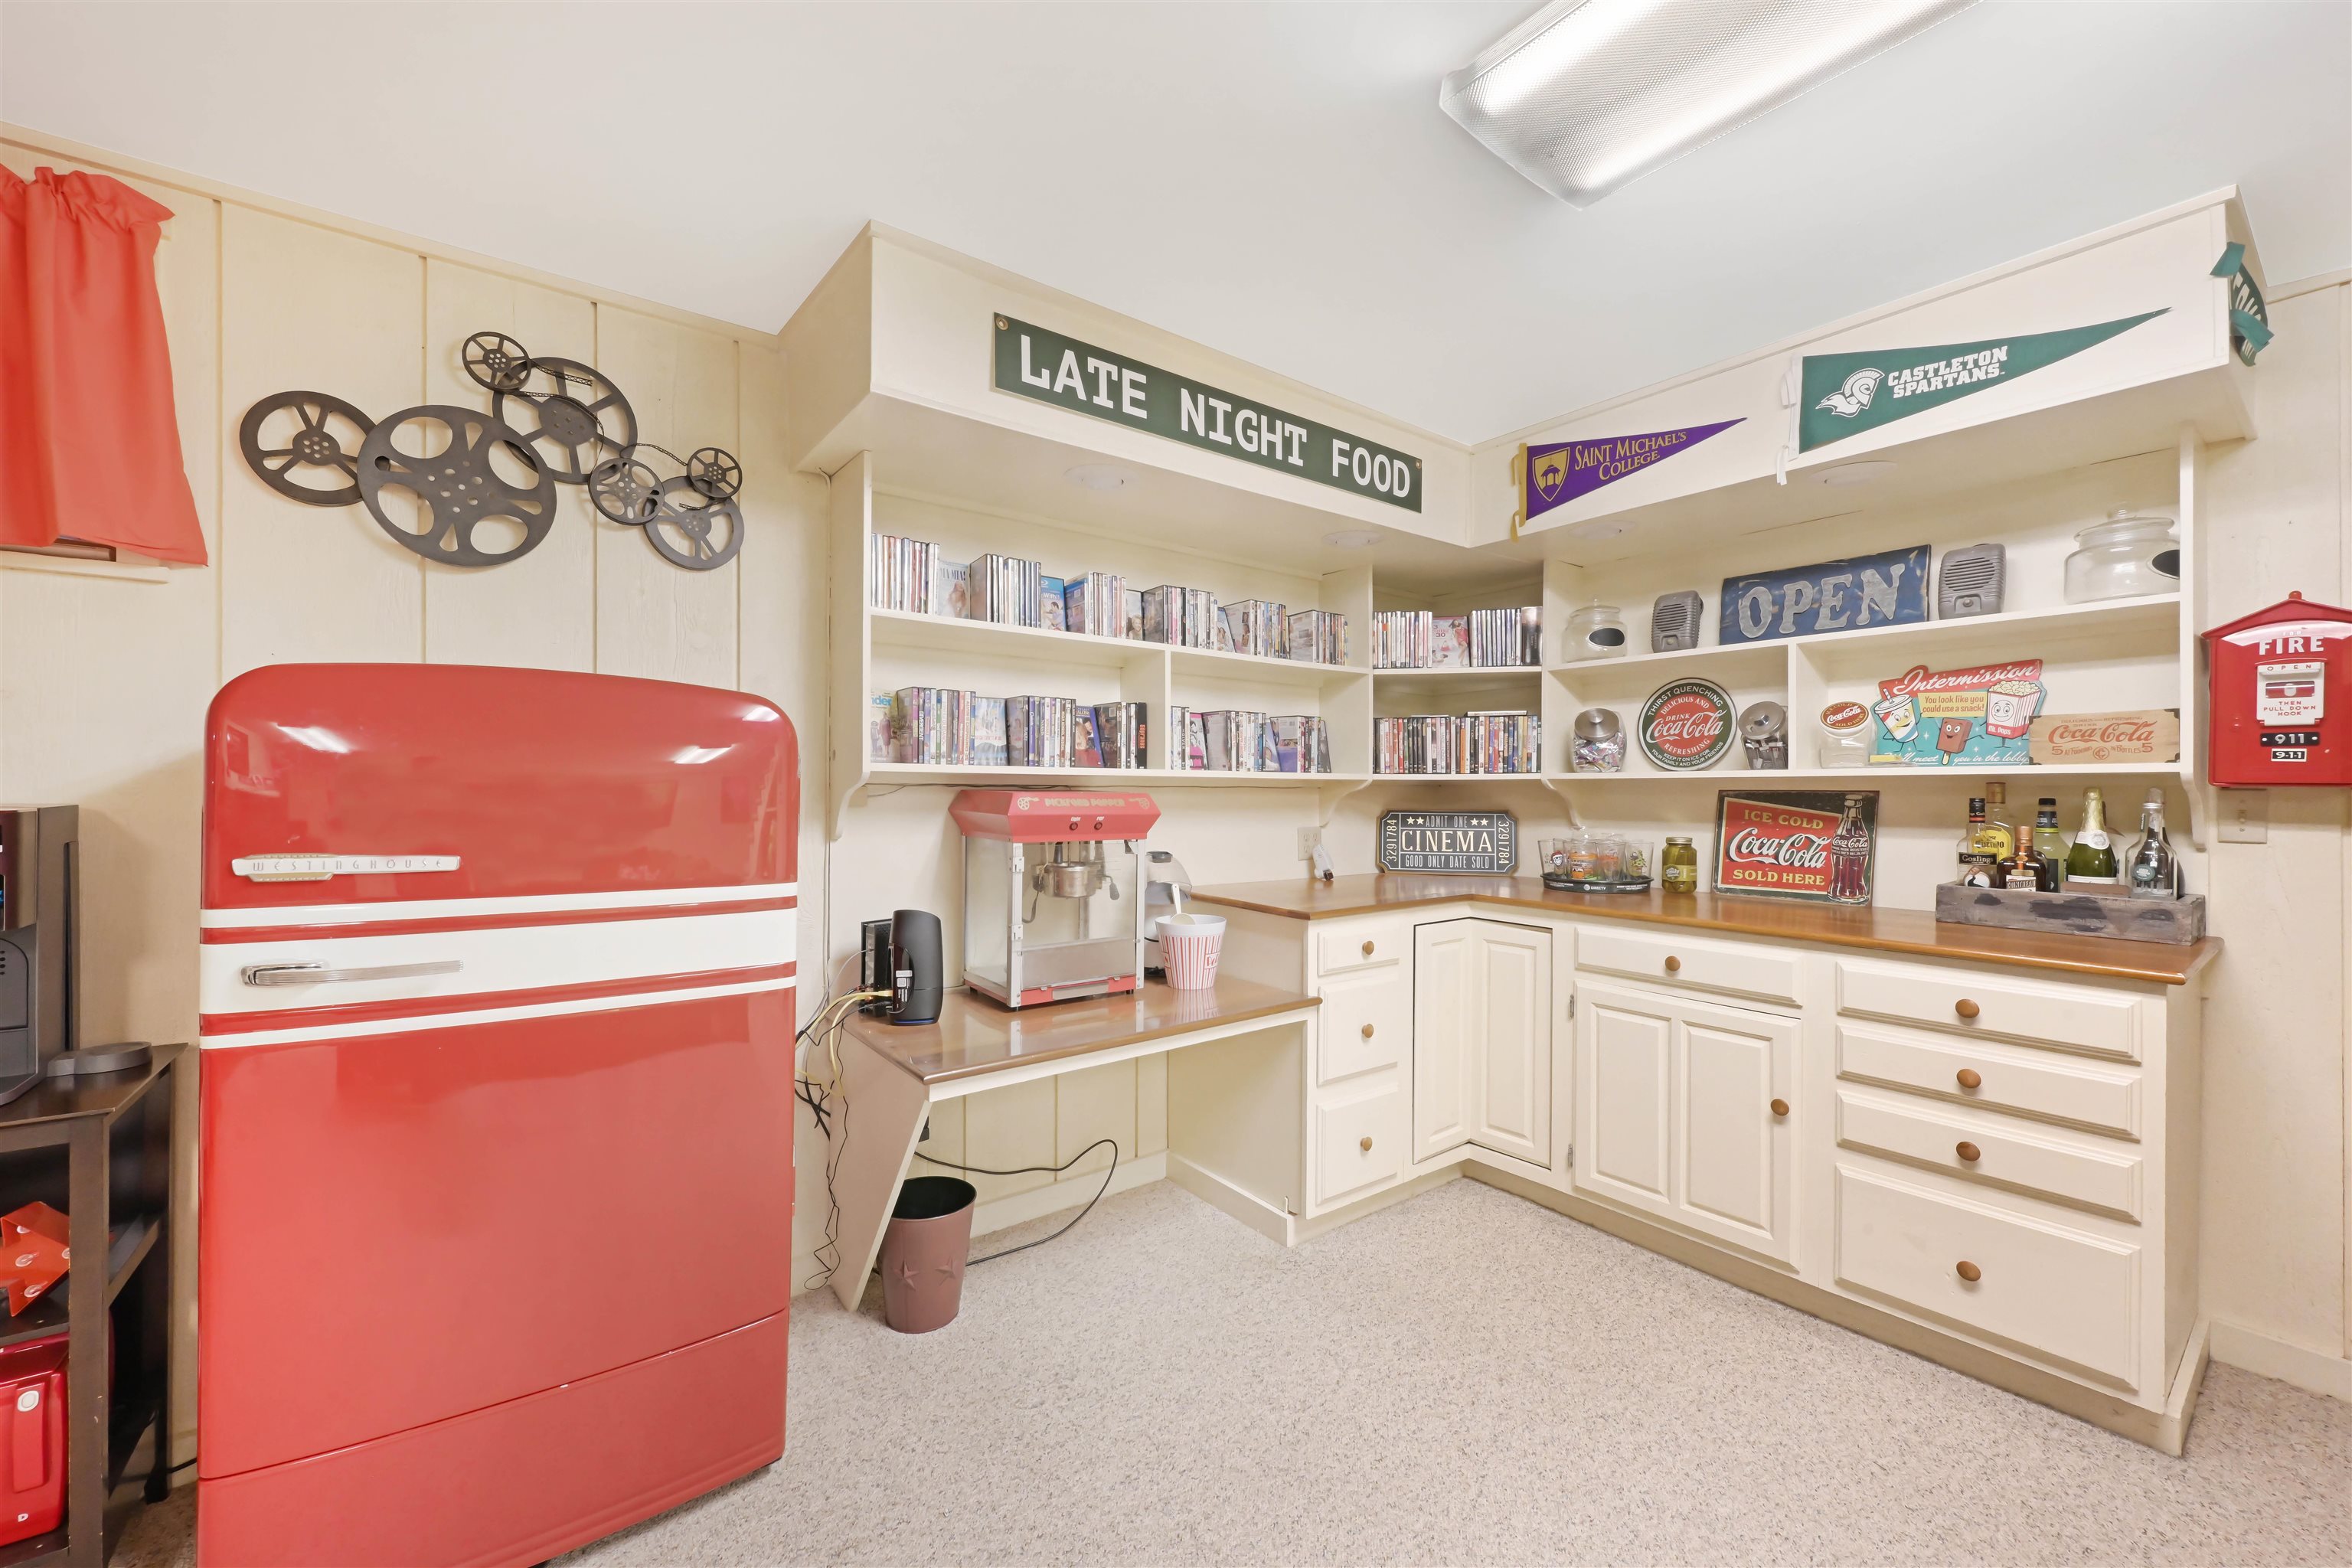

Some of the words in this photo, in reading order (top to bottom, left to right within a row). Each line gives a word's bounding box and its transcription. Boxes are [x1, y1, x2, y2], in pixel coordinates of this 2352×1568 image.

[1887, 345, 2008, 387] CASTLETON
[1893, 363, 2001, 399] SPARTANS
[1021, 334, 1148, 419] LATE
[1181, 387, 1308, 466] NIGHT
[1331, 439, 1411, 498] FOOD
[1575, 445, 1612, 471] SAINT
[1615, 432, 1687, 459] MICHAEL'S
[1599, 450, 1659, 481] COLLEGE
[1738, 563, 1906, 639] OPEN
[2259, 636, 2324, 655] FIRE
[1893, 665, 2037, 695] Intermission
[1648, 691, 1672, 717] THIRST
[1673, 685, 1723, 707] QUENCHING
[1660, 696, 1694, 715] DELICIOUS
[1694, 697, 1710, 709] AND
[1924, 695, 1937, 704] You
[1938, 694, 1954, 703] look
[1955, 694, 1969, 703] like
[1960, 704, 1984, 712] snack!
[1665, 713, 1690, 722] DRINK
[1826, 705, 1861, 724] Coca-Cola
[1645, 709, 1727, 743] Coca-Cola
[2048, 720, 2158, 744] Coca-Cola
[1664, 738, 1710, 755] REFRESHING
[2275, 733, 2305, 744] 911
[1651, 748, 1662, 760] YOUR
[1661, 756, 1679, 766] FAMILY
[1705, 741, 1723, 760] FRIENDS
[1663, 753, 1677, 761] KEEP
[1700, 749, 1710, 757] FOR
[1954, 755, 1971, 766] you
[1972, 753, 1983, 762] in
[1984, 751, 2001, 762] the
[2004, 751, 2030, 766] lobby
[2052, 746, 2063, 756] 5
[2141, 743, 2154, 753] 5
[1426, 816, 1448, 828] ADMIT
[1454, 816, 1468, 828] ONE
[1744, 809, 1772, 822] ICE
[1778, 815, 1824, 829] COLD
[1386, 819, 1397, 862] 3291784
[1402, 830, 1492, 852] CINEMA
[1498, 821, 1510, 864] 3291784
[1729, 827, 1831, 869] Coca-Cola
[1832, 836, 1868, 848] Coca-Cola
[253, 860, 442, 871] WESTINGHOUSE
[1405, 854, 1423, 867] GOOD
[1428, 855, 1445, 868] ONLY
[1449, 856, 1467, 868] DATE
[1472, 856, 1489, 869] SOLD
[1962, 854, 1994, 864] Goslings
[1733, 869, 1779, 882] SOLD
[1782, 873, 1825, 886] HERE
